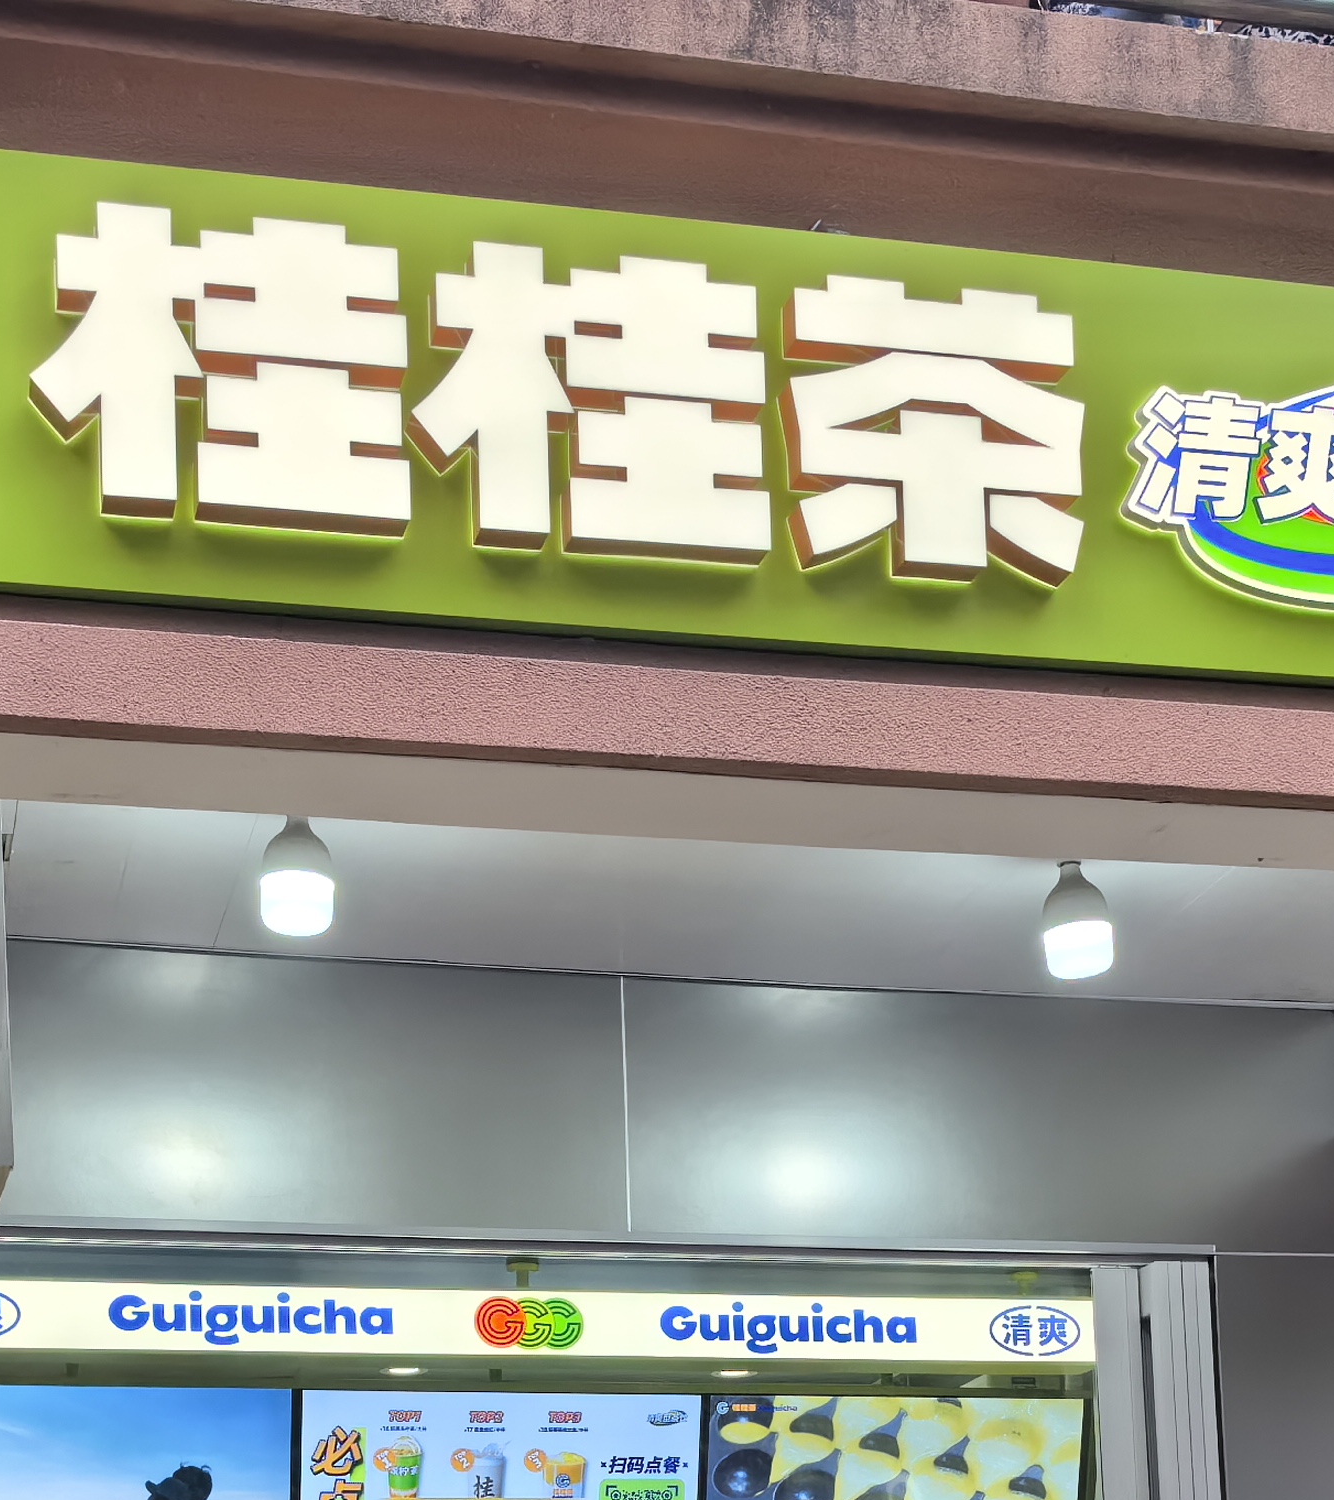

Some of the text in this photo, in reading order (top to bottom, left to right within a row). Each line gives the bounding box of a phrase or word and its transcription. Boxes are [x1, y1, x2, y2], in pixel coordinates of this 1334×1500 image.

[30, 200, 1087, 584] 桂桂茶
[109, 1291, 394, 1346] Guiguicha
[659, 1302, 917, 1354] Guiguicha
[1000, 1311, 1070, 1348] 清爽
[608, 1456, 681, 1475] 扫码点餐
